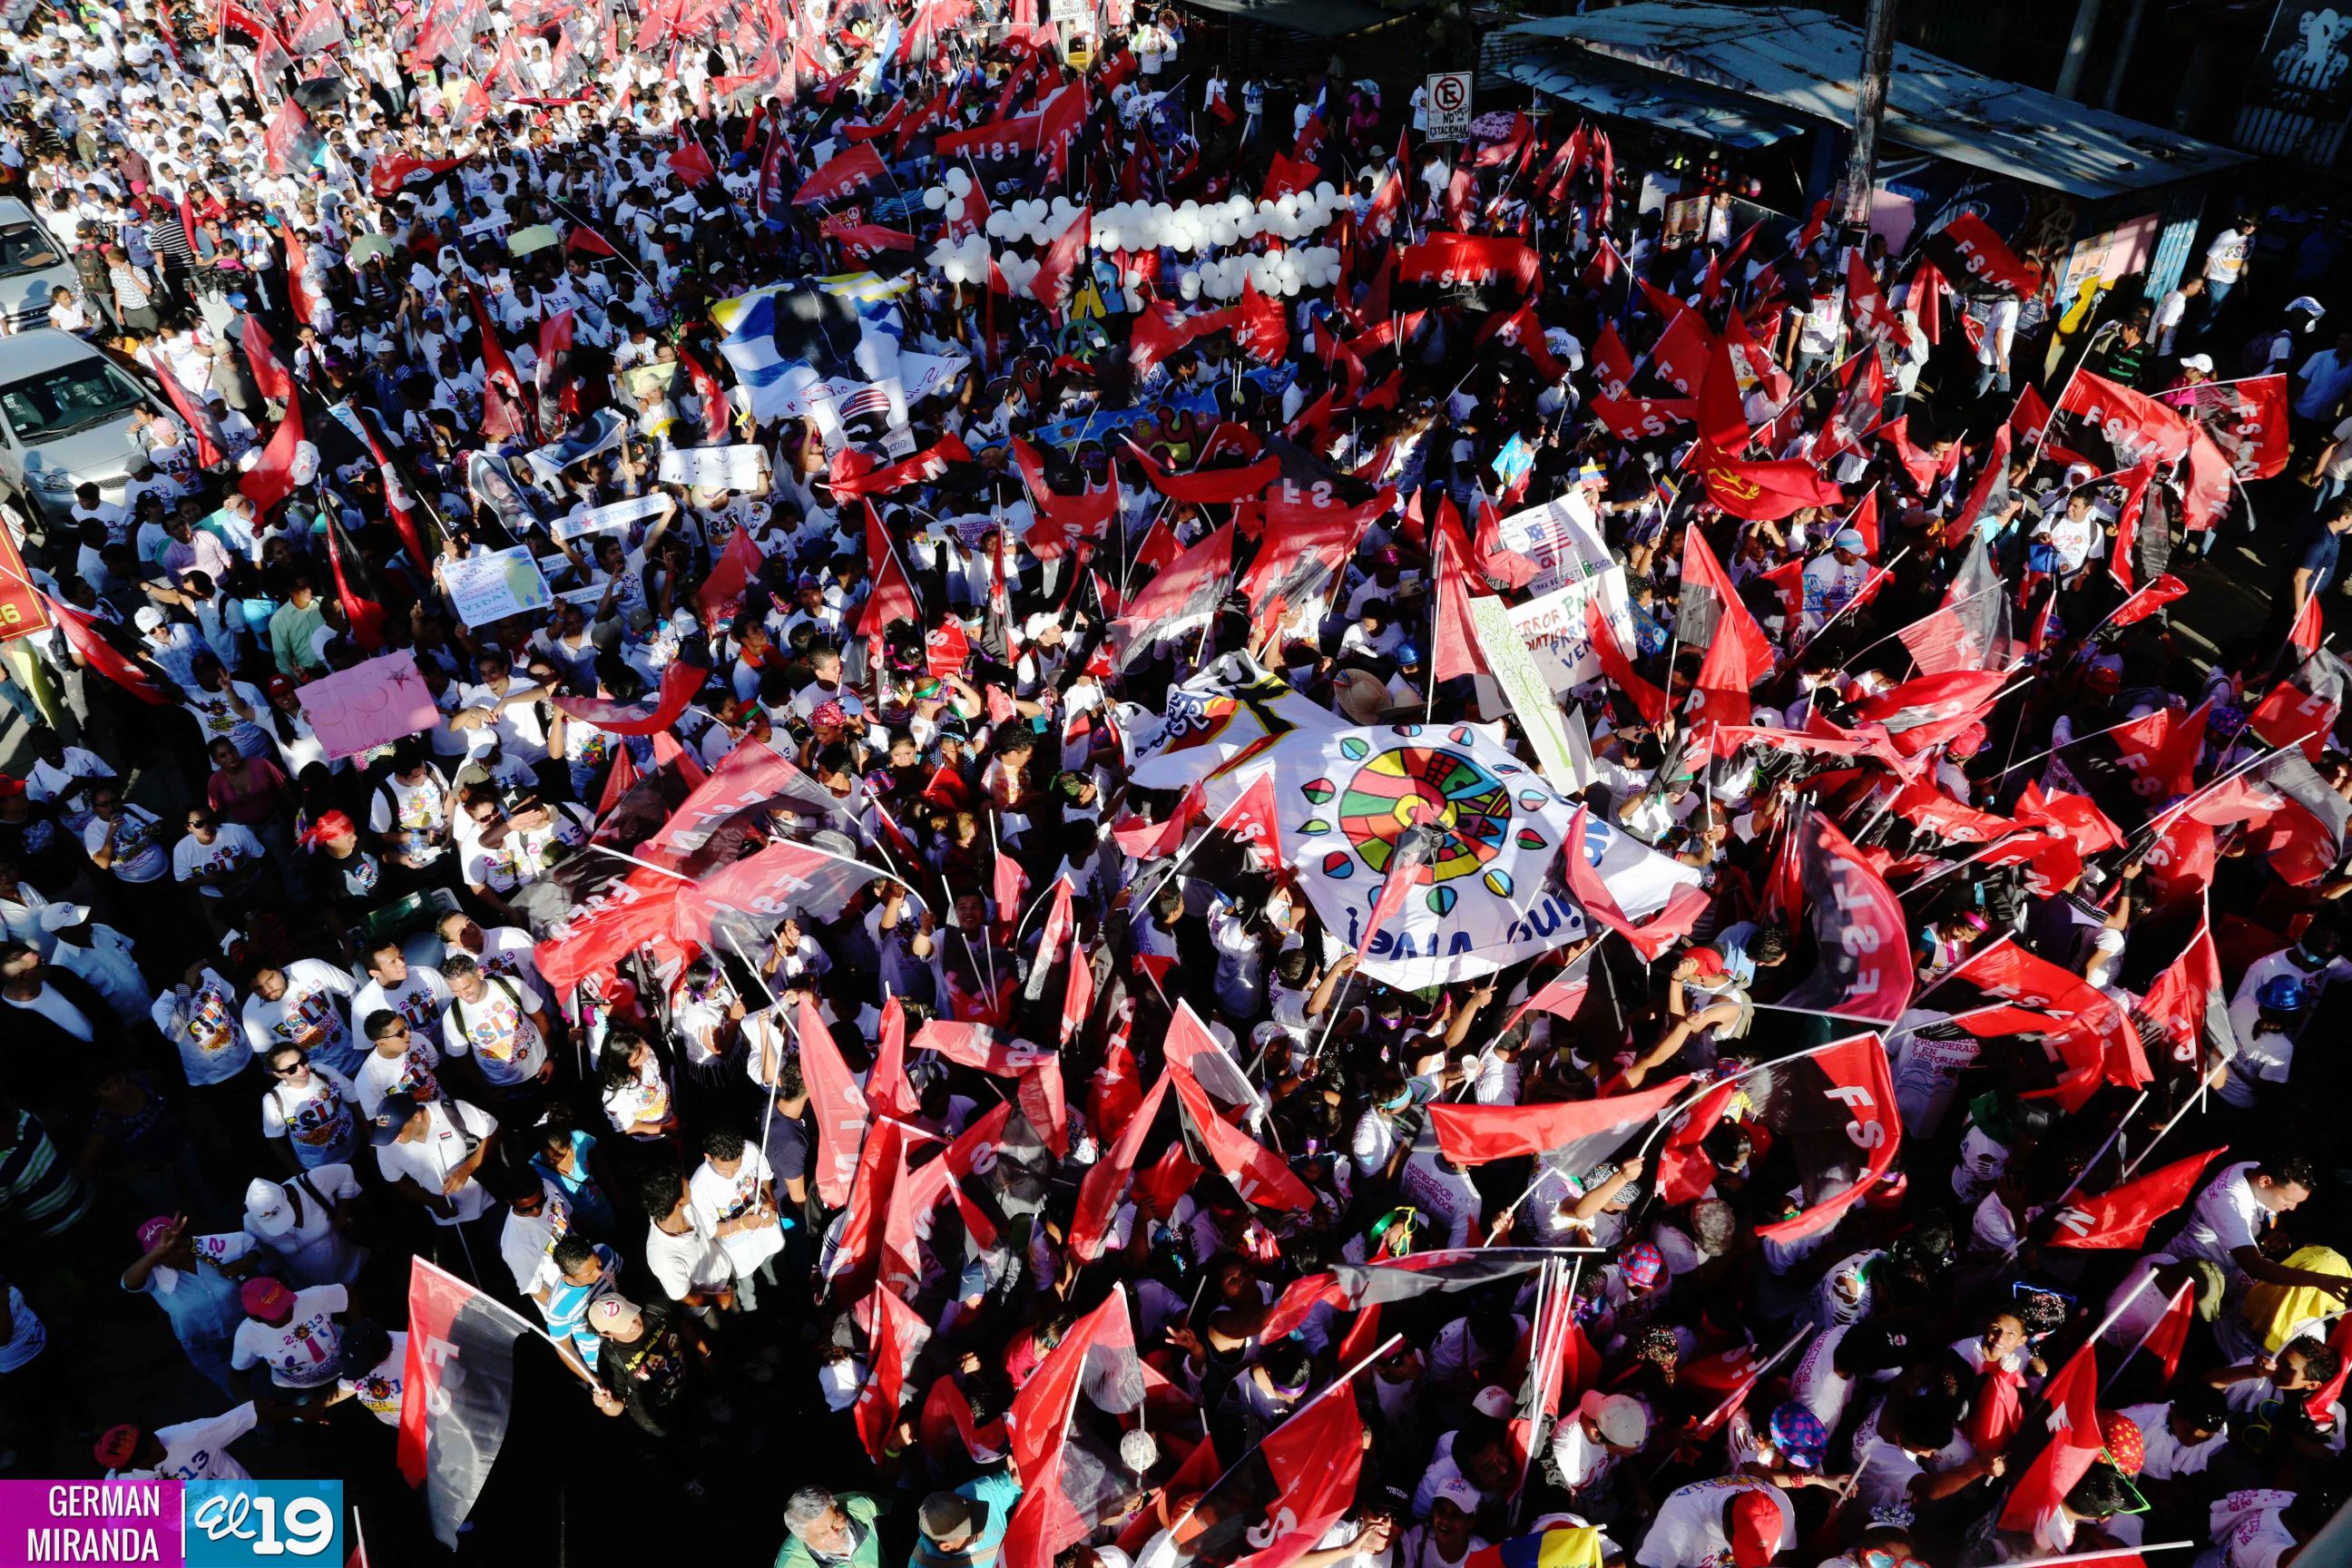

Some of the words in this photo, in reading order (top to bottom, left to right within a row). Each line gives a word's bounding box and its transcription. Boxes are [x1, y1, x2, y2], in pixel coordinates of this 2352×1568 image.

[1443, 113, 1454, 123] NO
[1429, 124, 1468, 138] ESTACIONAR
[1955, 239, 2015, 290] FSLN
[1419, 267, 1498, 289] FSLN
[2082, 405, 2166, 455] FSLN
[2231, 404, 2263, 477] FSLN
[1540, 550, 1564, 570] CNN
[1922, 1046, 1937, 1055] EN
